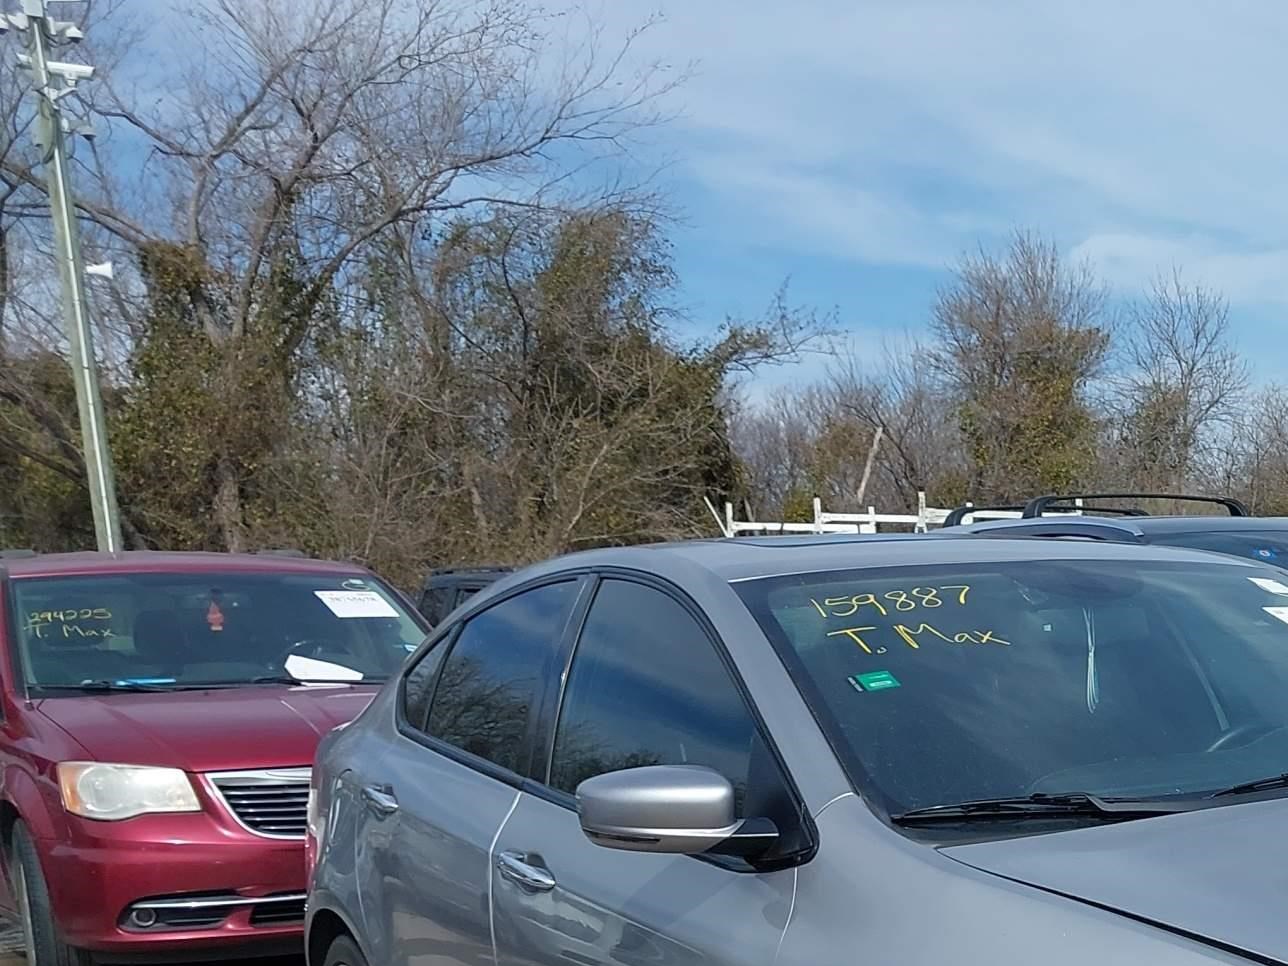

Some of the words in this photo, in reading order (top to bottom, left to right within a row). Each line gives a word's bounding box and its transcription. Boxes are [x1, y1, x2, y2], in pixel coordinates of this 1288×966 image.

[810, 585, 970, 618] 159887
[61, 623, 117, 639] Max
[826, 625, 888, 654] T.
[893, 622, 1012, 649] Max
